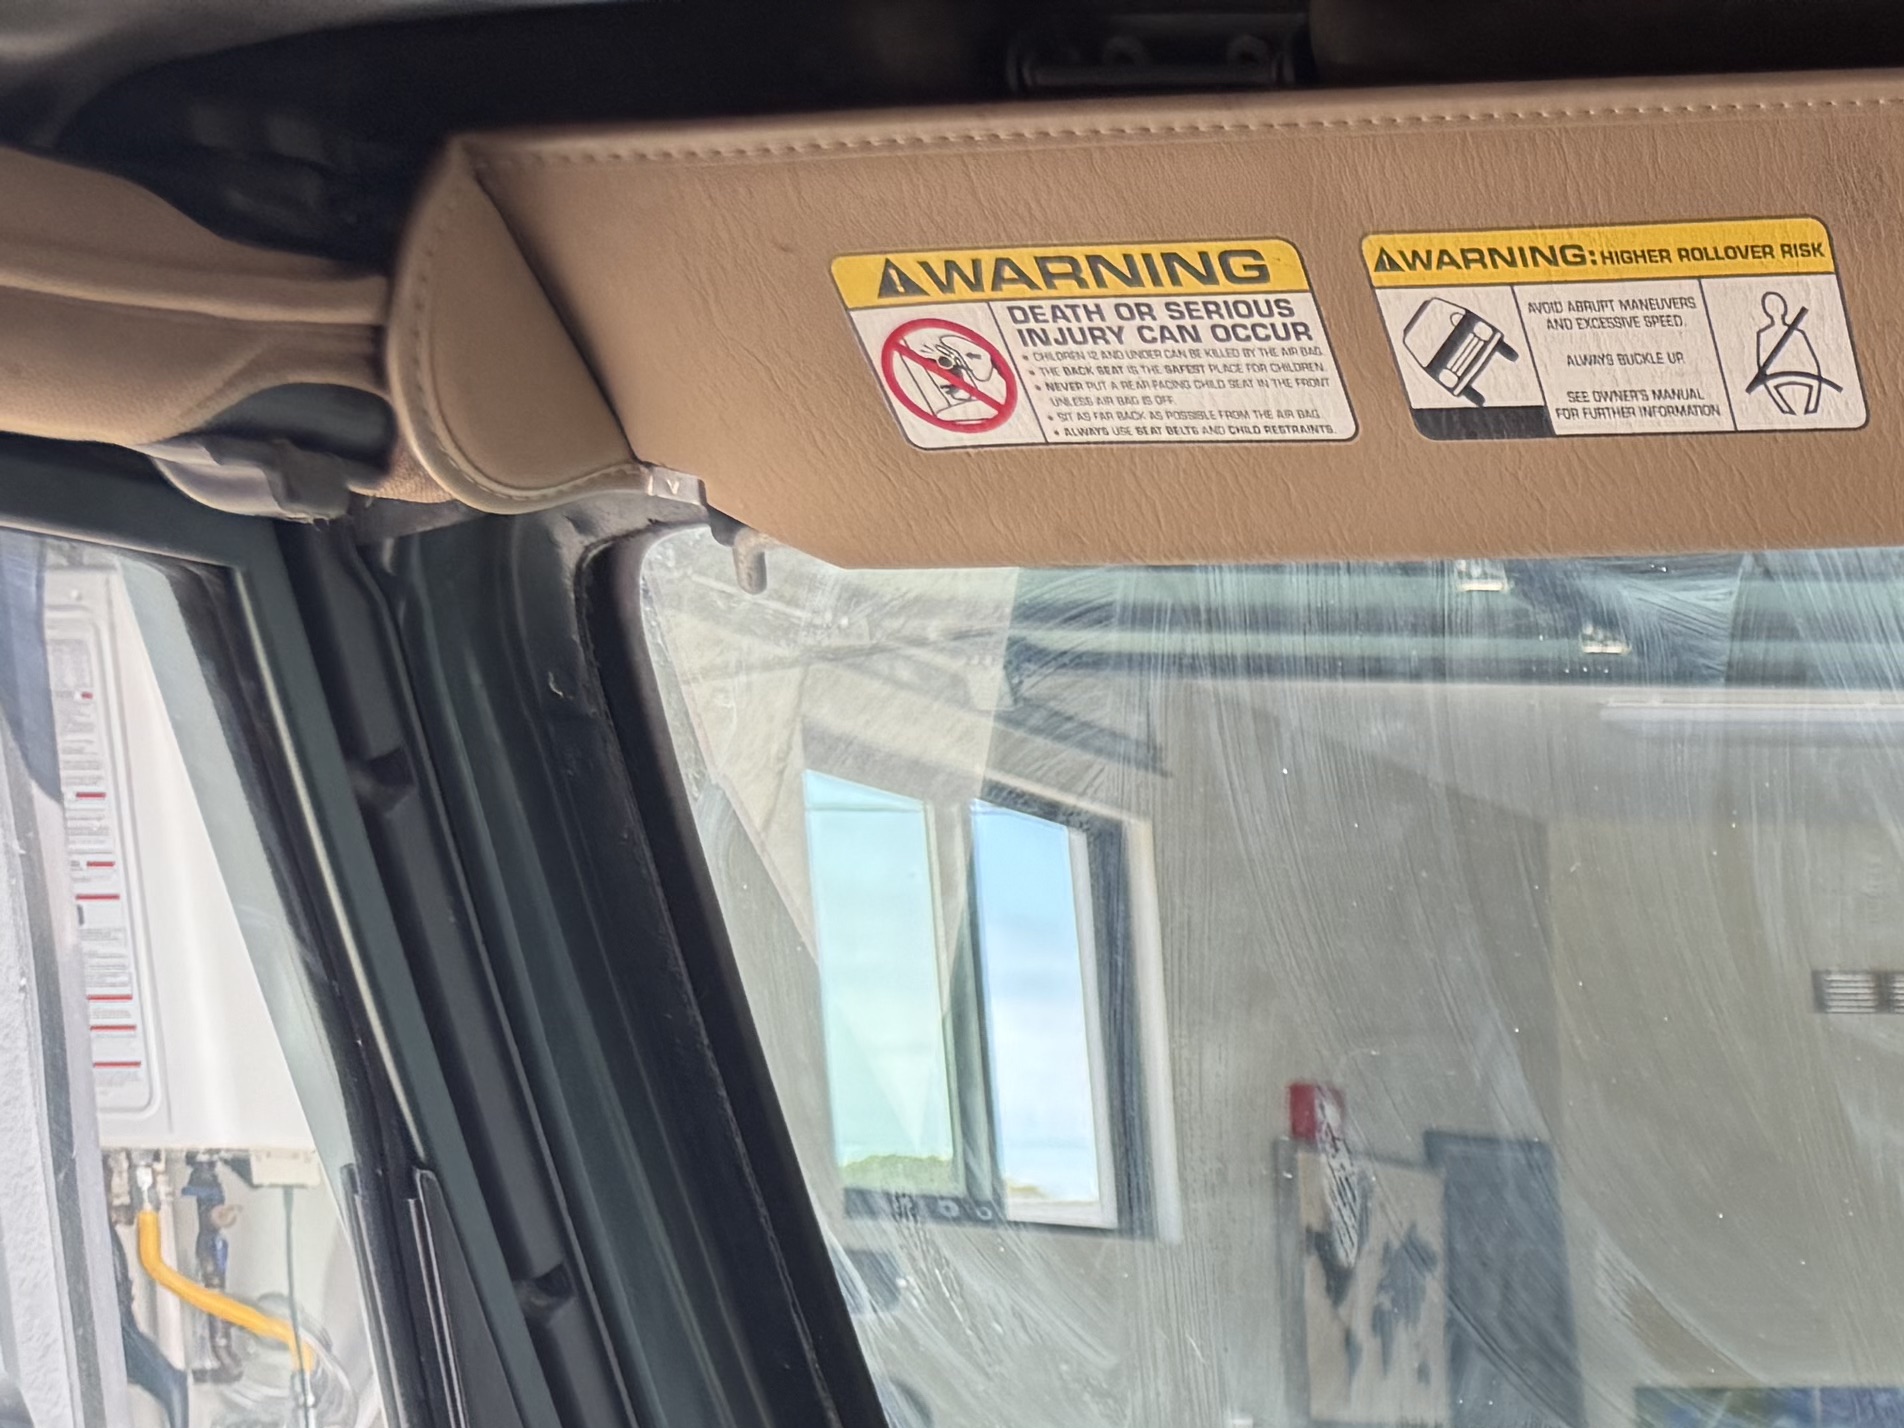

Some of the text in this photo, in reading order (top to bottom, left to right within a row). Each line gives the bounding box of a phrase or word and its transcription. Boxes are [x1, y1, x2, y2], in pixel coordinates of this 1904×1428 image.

[1399, 241, 1825, 271] WARNING: HIGHER ROLLOVER RISK
[914, 248, 1271, 294] WARNING
[1006, 297, 1295, 324] DEATH OR SERIOUS
[1526, 296, 1697, 314] AVOID ABRUPT MANEUVERS
[1545, 318, 1573, 331] AND
[1575, 315, 1641, 329] EXCESSIVE
[1015, 320, 1314, 347] INJURY CAN OCCUR
[1565, 353, 1614, 366] ALWAYS
[1616, 352, 1664, 365] BUCKLE
[1566, 390, 1590, 403] SEE
[1651, 387, 1704, 400] MANUAL
[1554, 403, 1721, 419] FOR FURTHER INFORMATION
[1062, 427, 1110, 436] ALWAYS
[1111, 426, 1133, 436] USE
[1134, 426, 1163, 435] SEAT
[1165, 426, 1199, 435] BELTS
[1200, 425, 1226, 434] AND
[1227, 425, 1262, 434] CHILD
